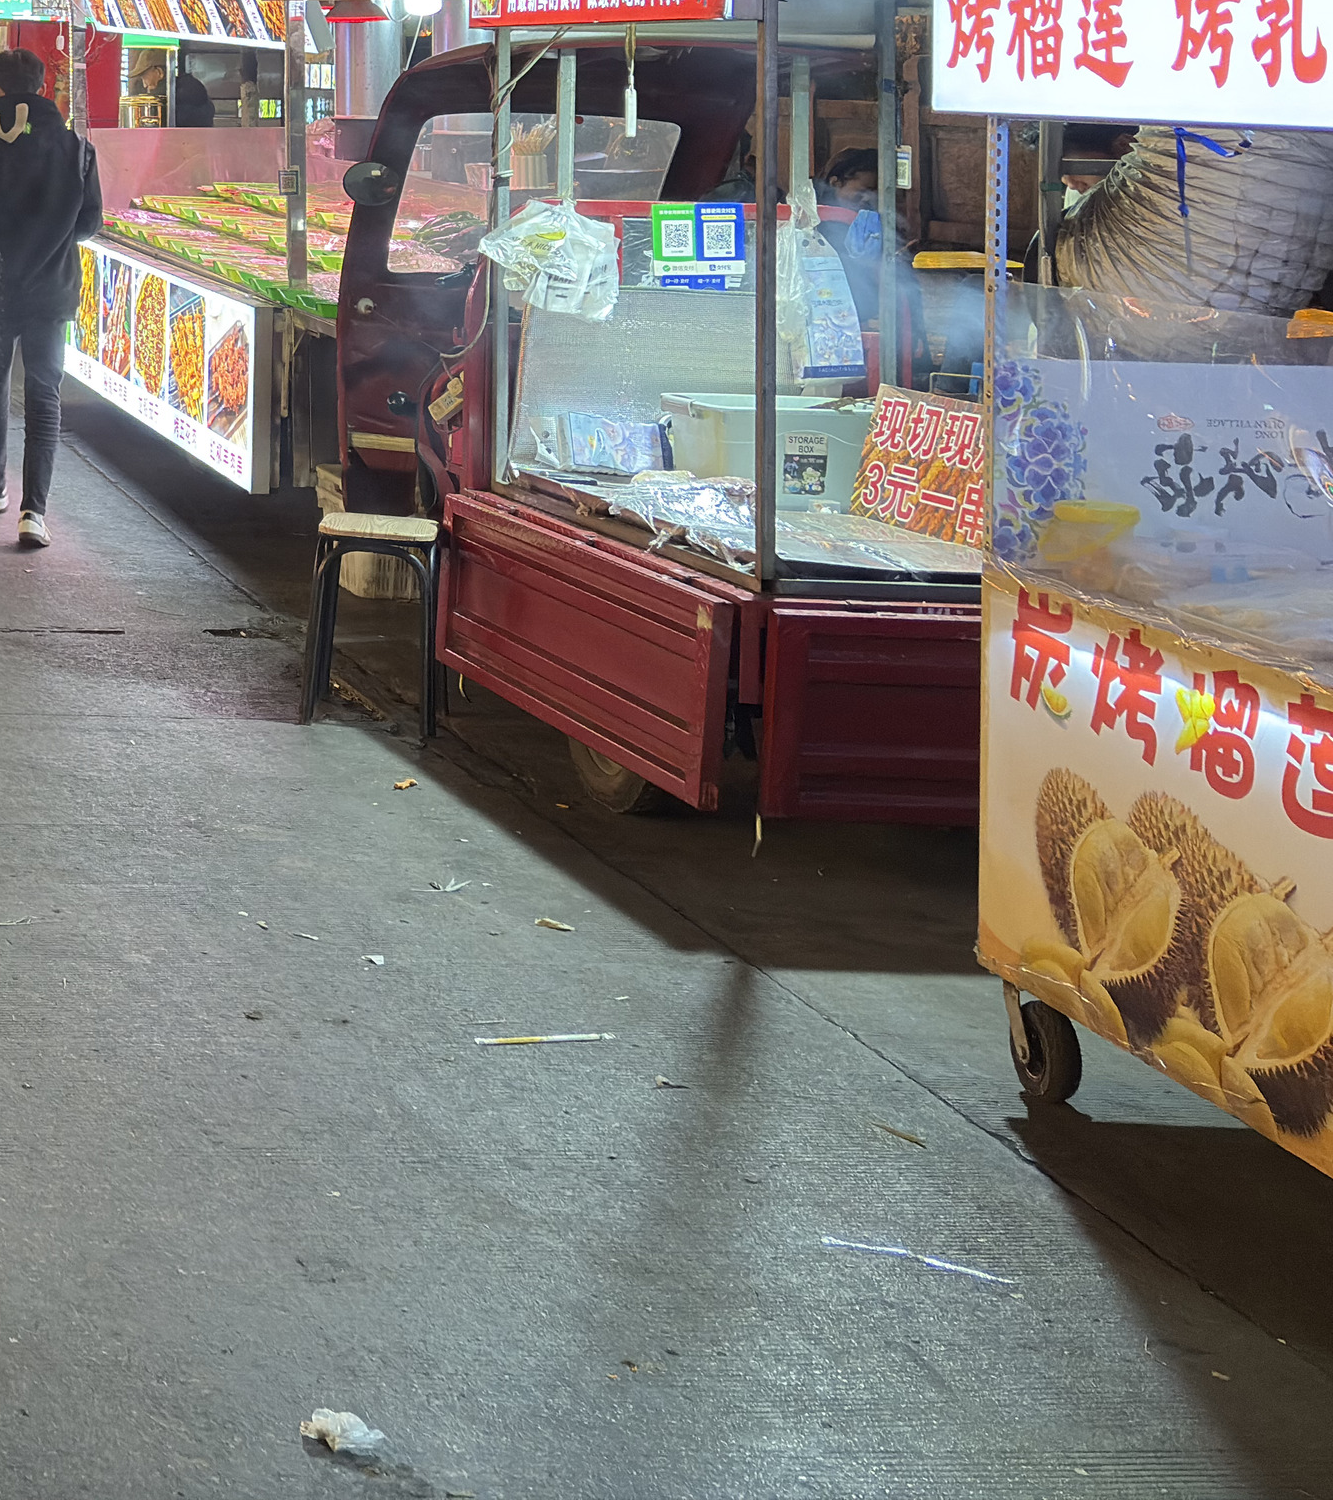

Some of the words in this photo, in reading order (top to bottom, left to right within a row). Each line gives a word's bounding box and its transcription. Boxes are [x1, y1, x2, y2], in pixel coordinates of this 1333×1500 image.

[1205, 418, 1251, 429] VILLAGE
[788, 435, 825, 445] STORAGE
[872, 396, 984, 473] 现切现
[798, 445, 814, 454] BOX
[861, 460, 984, 544] 3元一串
